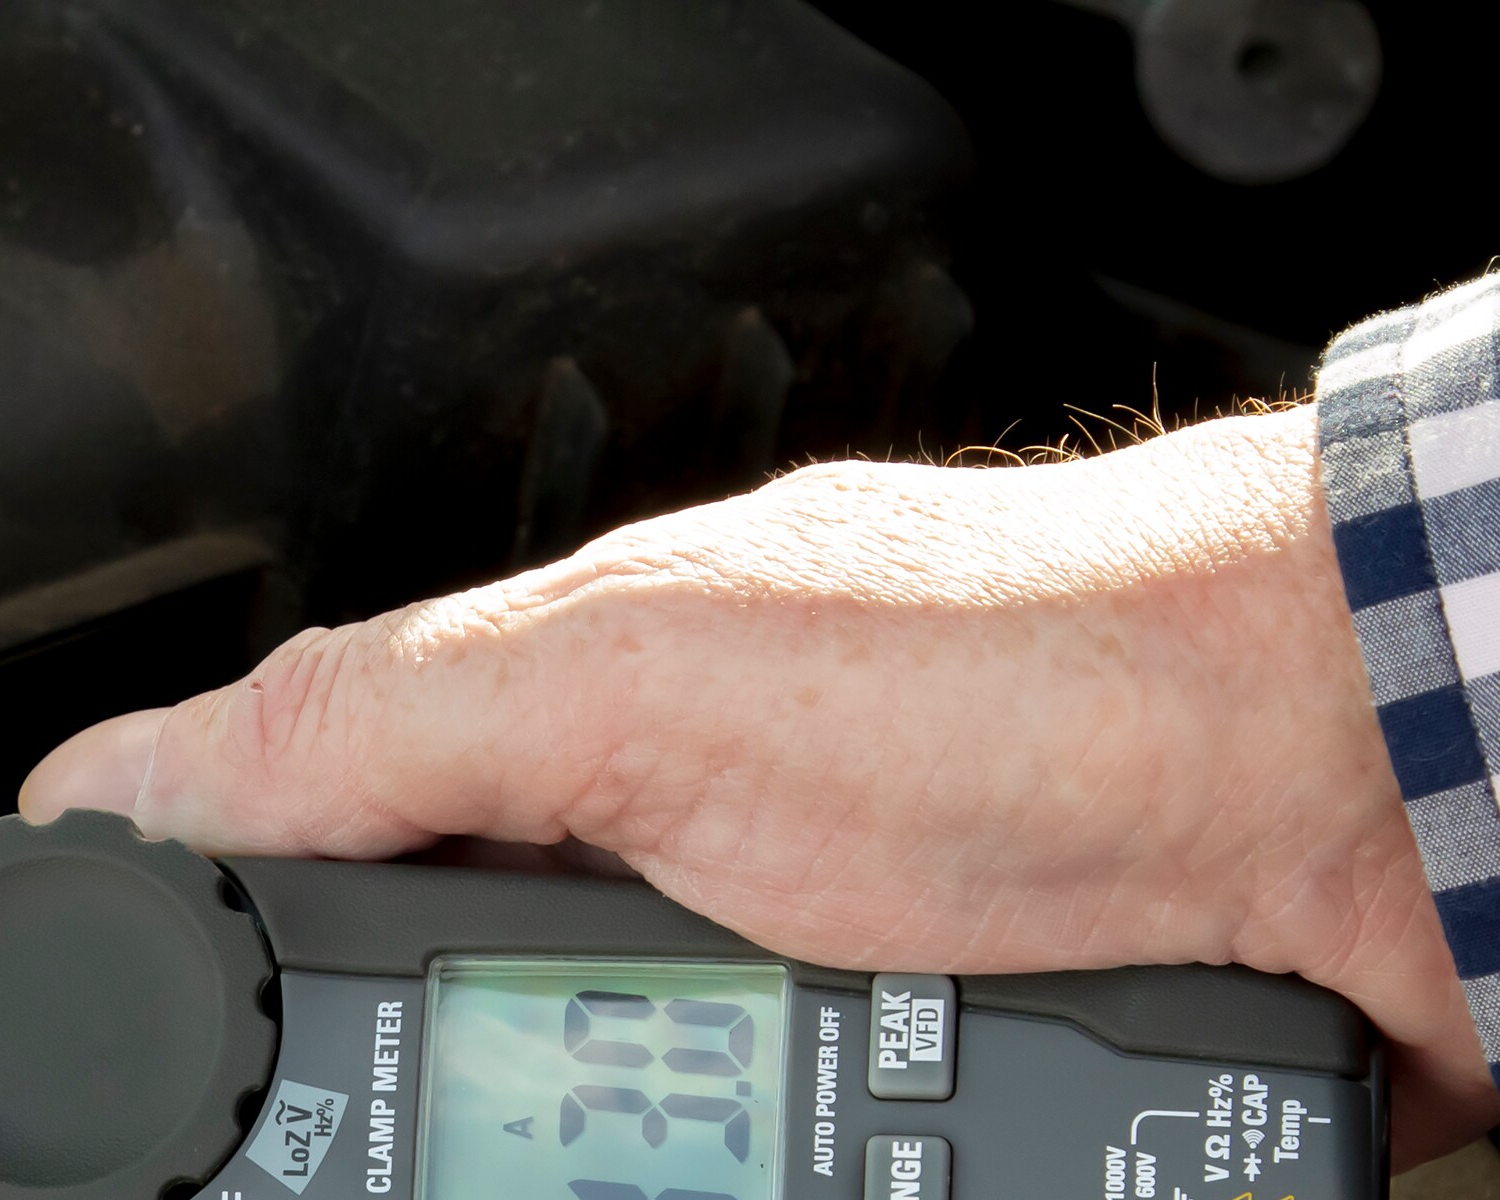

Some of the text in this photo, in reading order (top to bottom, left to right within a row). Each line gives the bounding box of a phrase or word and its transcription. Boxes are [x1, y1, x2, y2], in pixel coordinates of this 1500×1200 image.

[373, 1001, 403, 1092] METER
[878, 991, 911, 1069] PEAK
[915, 1007, 938, 1052] VFD
[313, 1098, 335, 1138] Hz%
[813, 1006, 841, 1177] AUTO POWER OFF
[1206, 1073, 1234, 1128] Hz%
[1242, 1074, 1269, 1126] CAP
[282, 1130, 312, 1177] LoZ
[366, 1099, 396, 1195] CLAMP
[502, 1115, 534, 1140] A
[1274, 1099, 1307, 1164] Temp
[1105, 1146, 1127, 1200] 1000V
[1135, 1152, 1157, 1199] 600V
[1204, 1164, 1231, 1182] V
